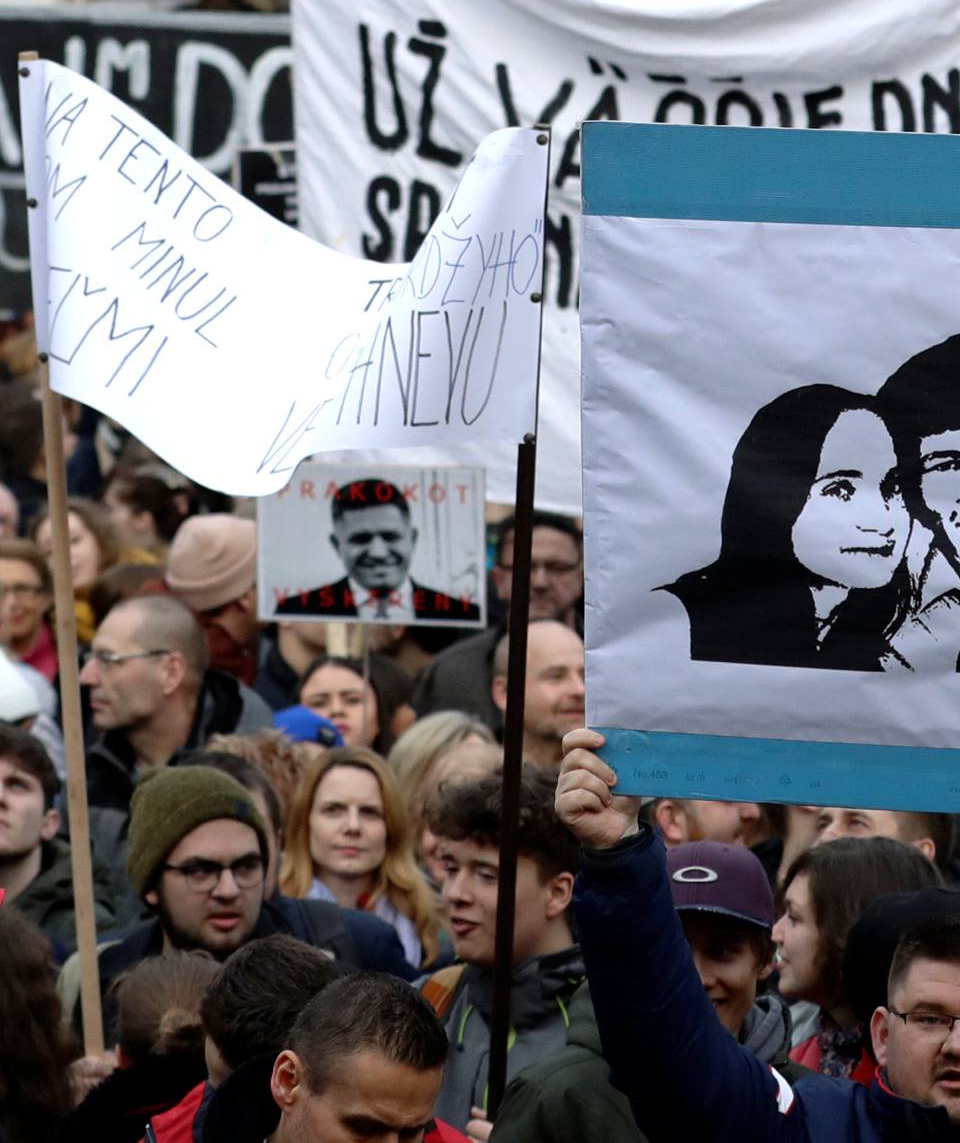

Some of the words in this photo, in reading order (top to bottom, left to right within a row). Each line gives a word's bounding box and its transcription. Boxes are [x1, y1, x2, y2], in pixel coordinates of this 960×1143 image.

[358, 19, 462, 166] UŽ
[99, 114, 233, 242] TENTO
[111, 221, 237, 349] MINUL
